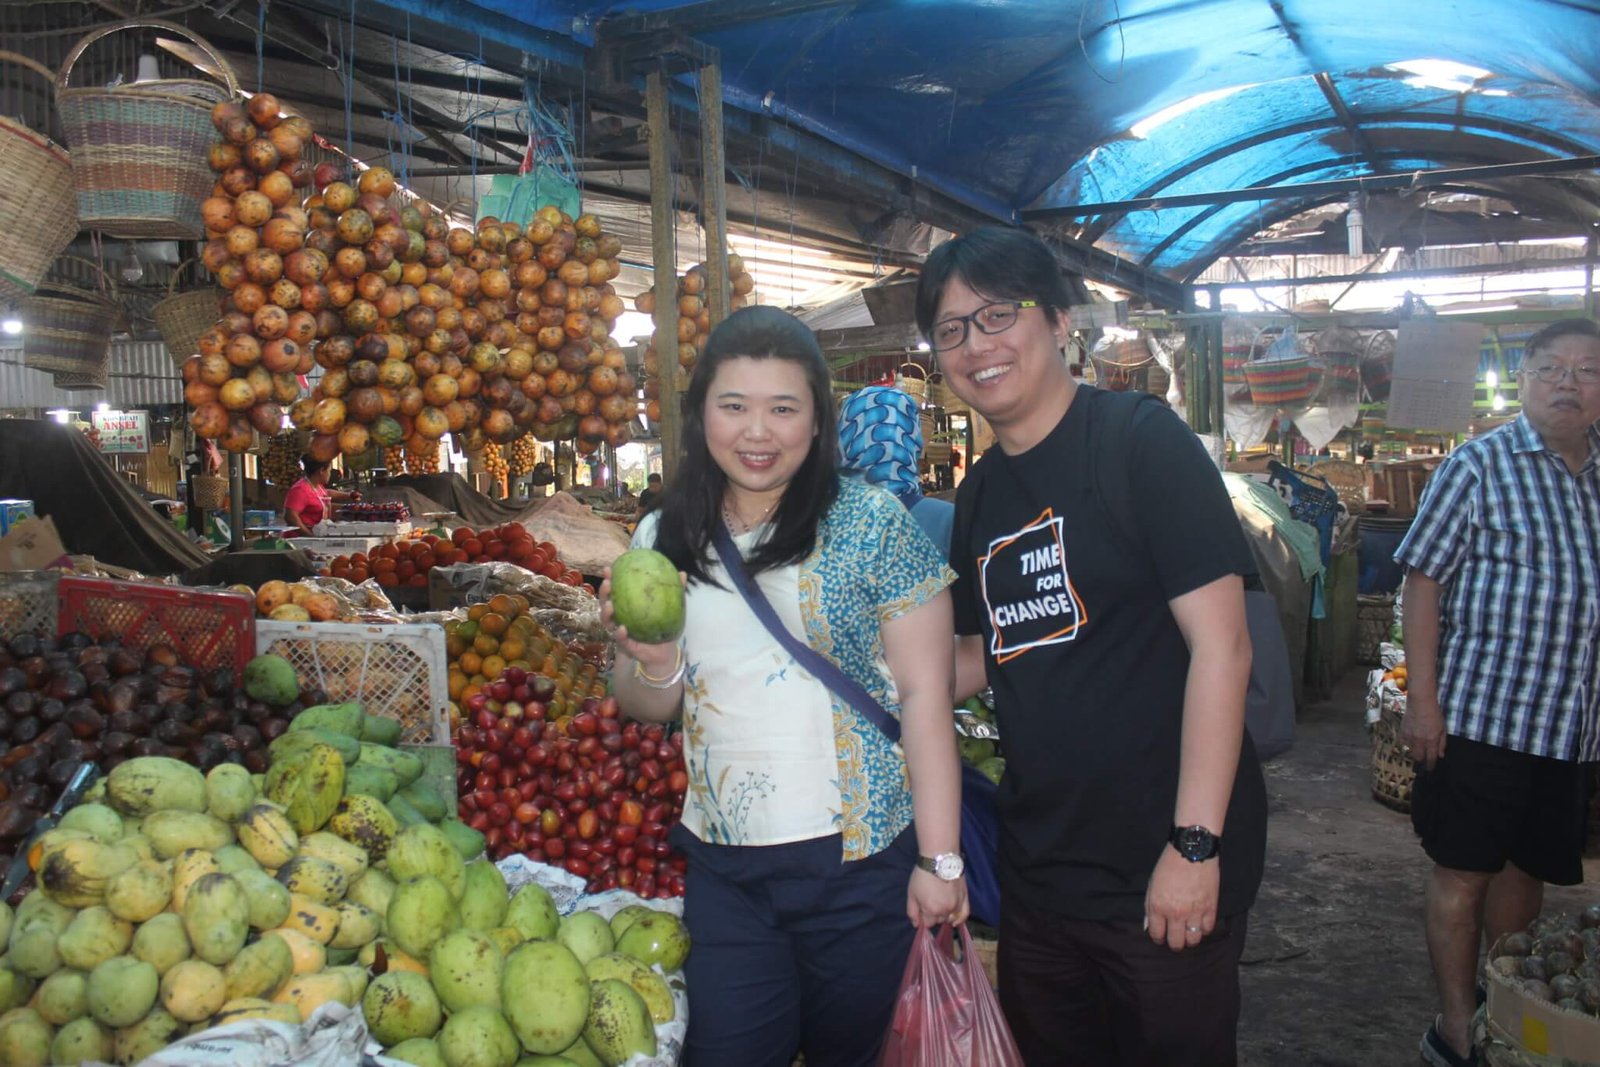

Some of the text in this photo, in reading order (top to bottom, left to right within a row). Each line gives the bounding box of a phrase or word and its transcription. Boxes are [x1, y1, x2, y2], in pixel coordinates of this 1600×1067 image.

[103, 421, 138, 430] ANSEL
[1020, 543, 1061, 575] TIME
[1036, 573, 1062, 592] FOR
[994, 593, 1072, 627] CHANGE
